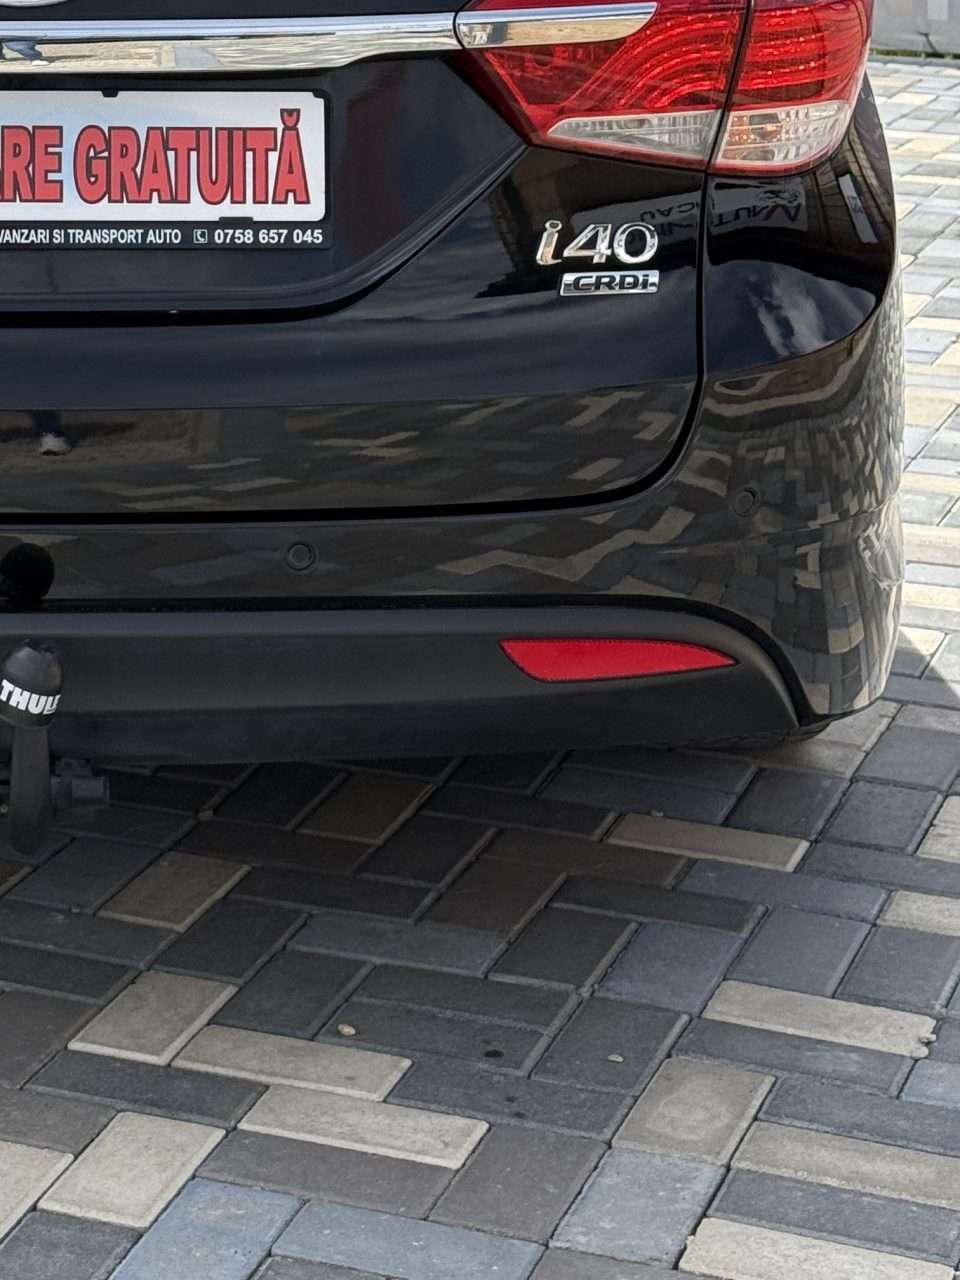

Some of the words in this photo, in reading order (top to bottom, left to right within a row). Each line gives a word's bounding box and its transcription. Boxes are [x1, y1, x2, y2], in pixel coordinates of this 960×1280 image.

[73, 108, 310, 204] GRATUITĂ
[53, 229, 65, 243] SI
[68, 229, 143, 243] TRANSPORT
[146, 229, 181, 243] AUTO
[214, 229, 253, 243] 0758
[258, 229, 286, 243] 657
[292, 229, 323, 243] 045
[536, 220, 659, 265] i40
[573, 274, 650, 291] CRDi
